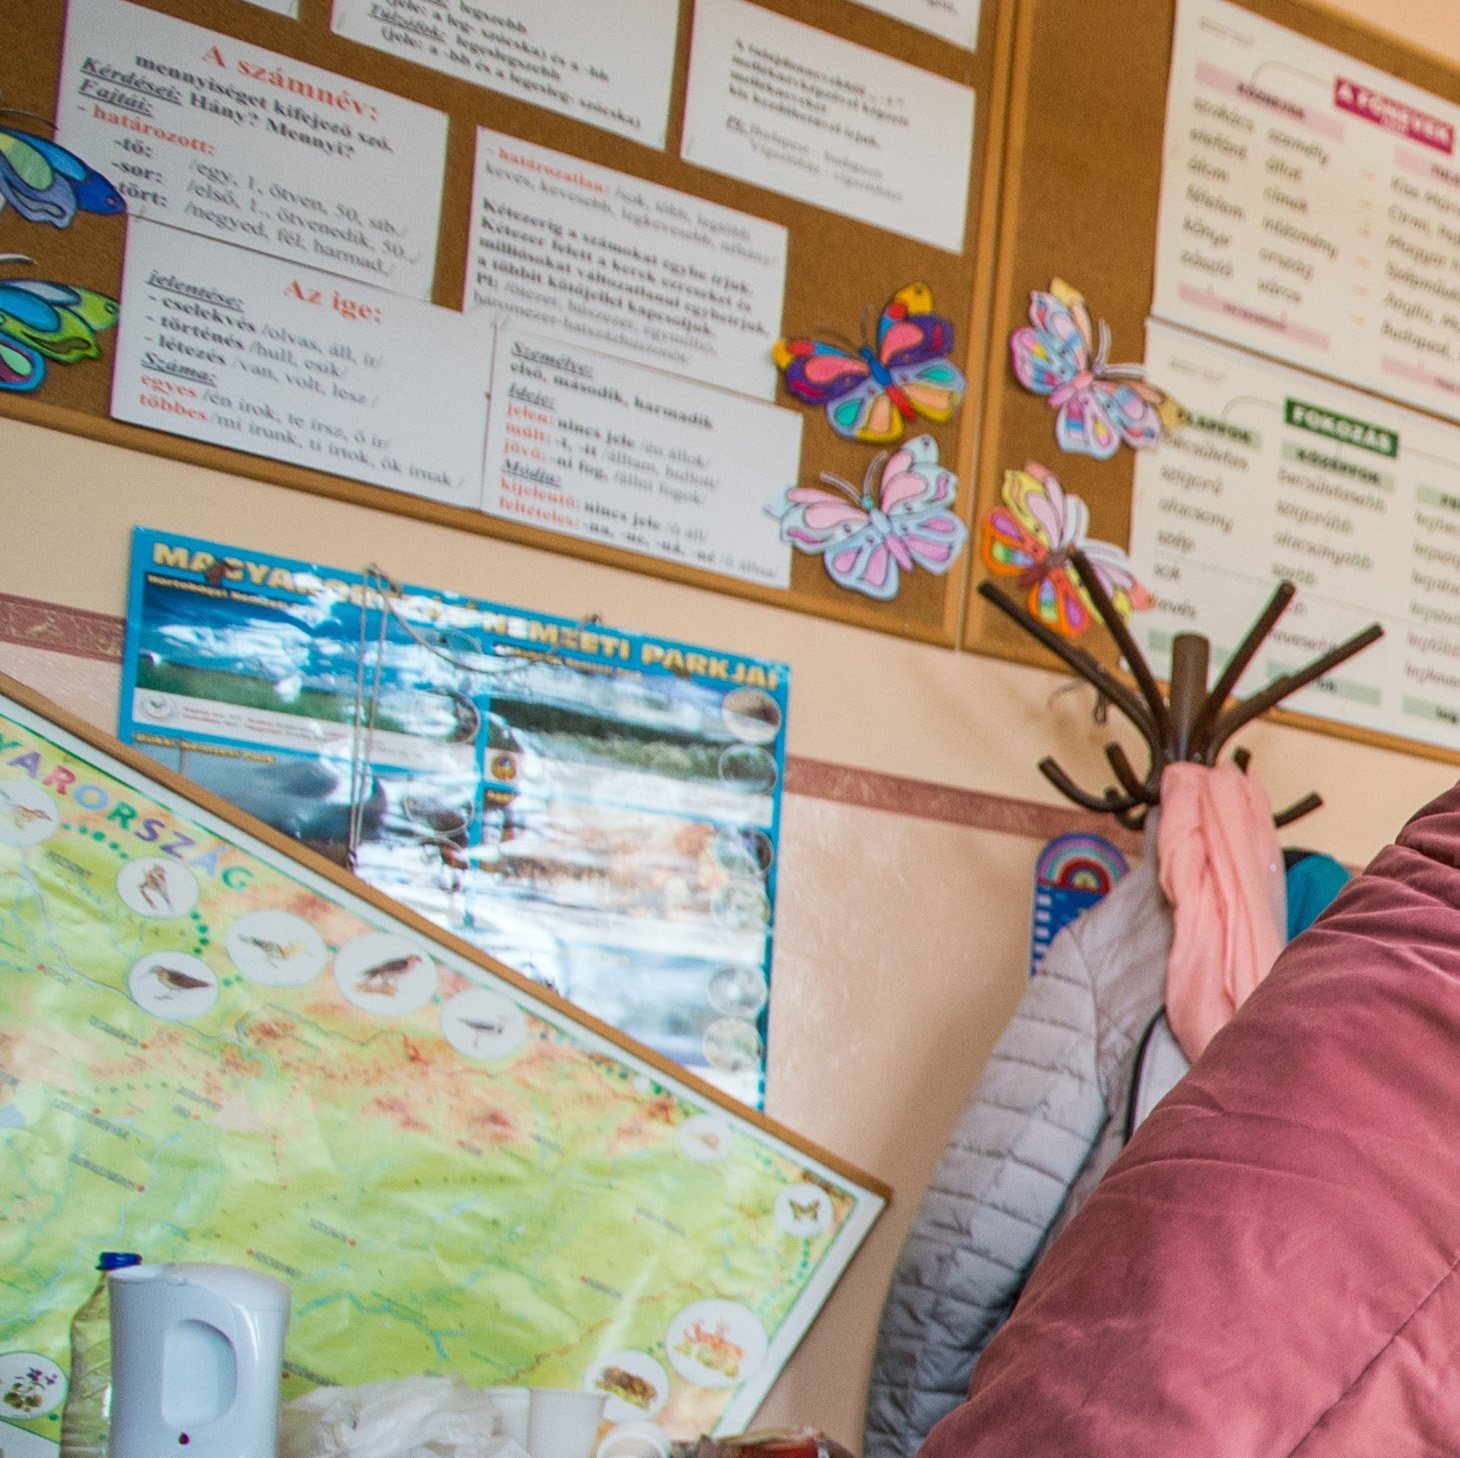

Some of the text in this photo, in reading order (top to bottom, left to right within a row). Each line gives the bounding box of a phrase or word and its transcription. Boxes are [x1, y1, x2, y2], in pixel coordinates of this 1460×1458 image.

[136, 55, 265, 110] mennyiséget
[202, 45, 378, 121] A számnév:
[80, 56, 354, 161] Kérdései: Hány? Mennyi?
[162, 296, 255, 332] cselekvés
[283, 279, 382, 324] Az ige:
[159, 335, 226, 363] létezés
[161, 317, 244, 347] történés
[138, 392, 206, 420] többes
[140, 374, 198, 398] egyes
[641, 643, 779, 690] PARKJAI
